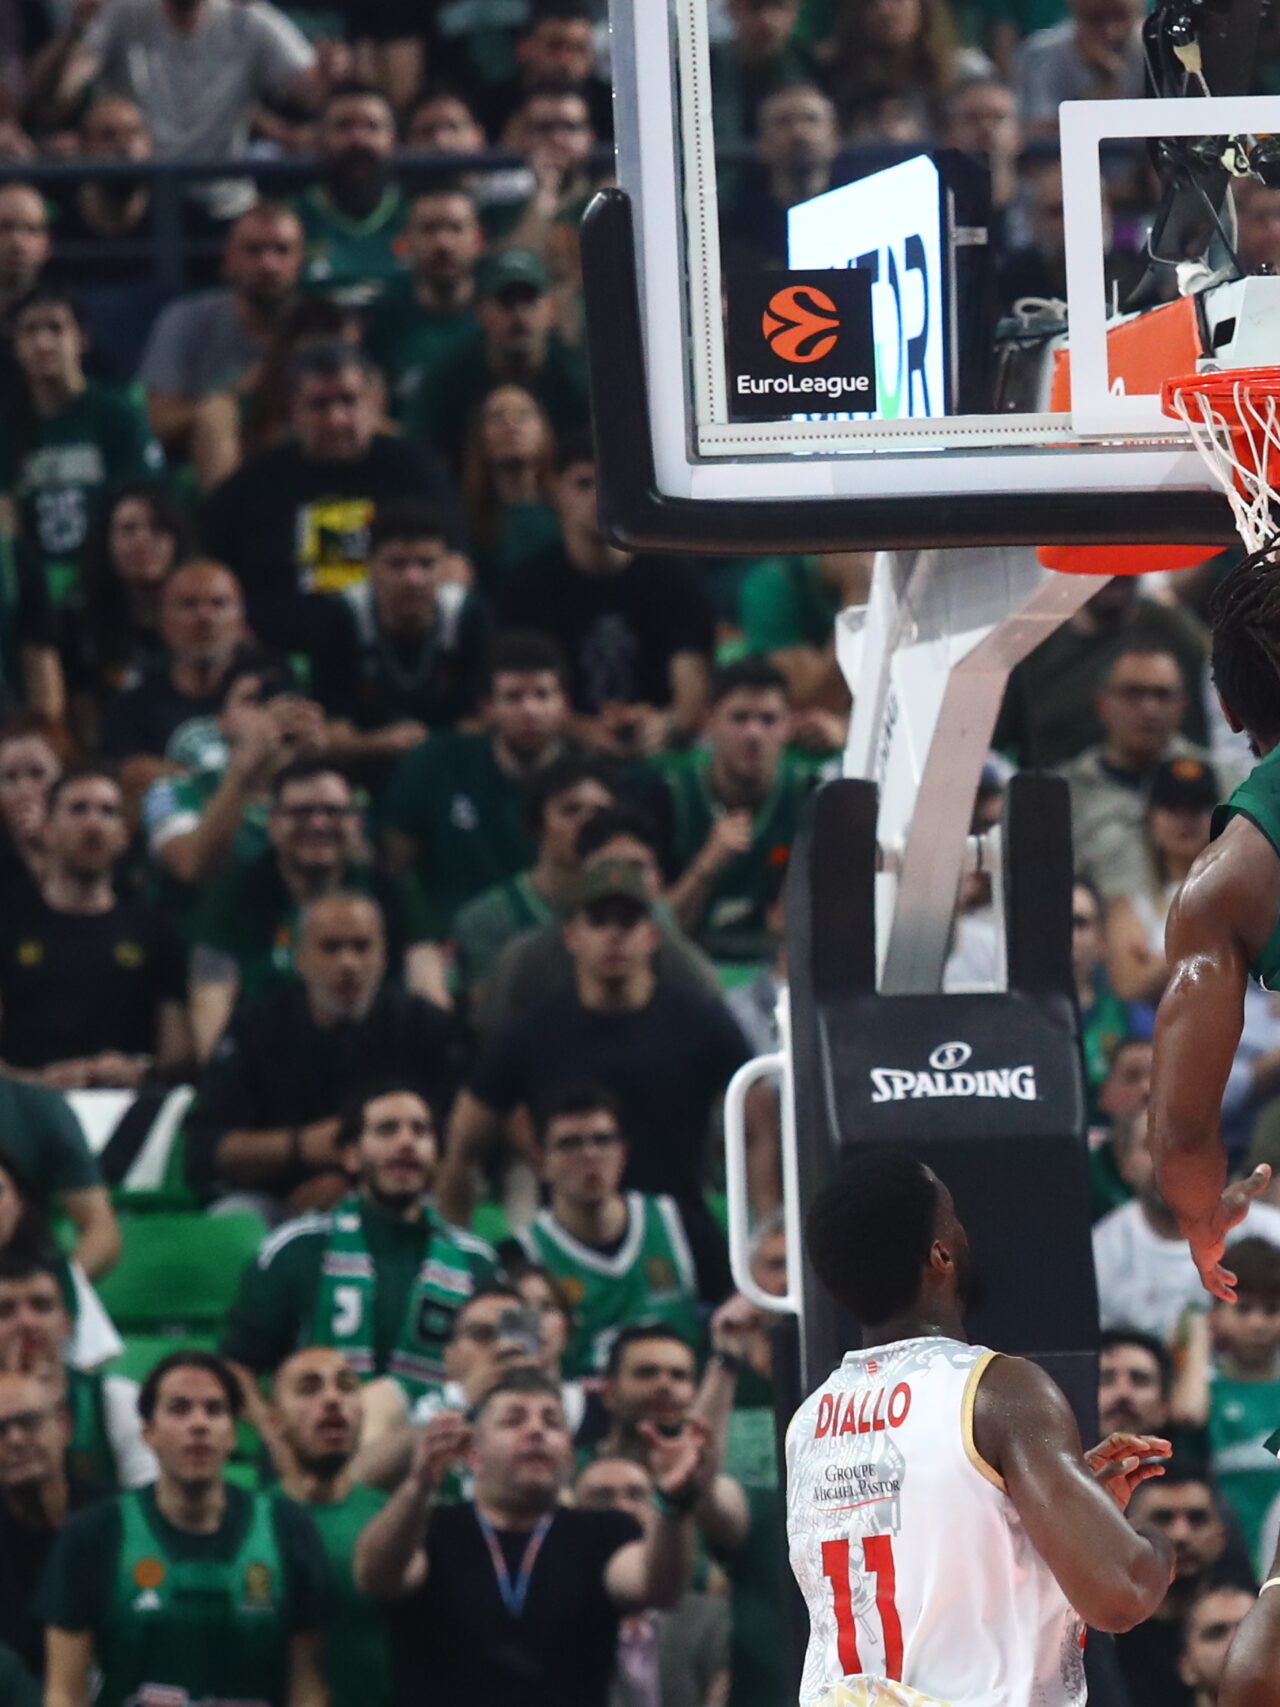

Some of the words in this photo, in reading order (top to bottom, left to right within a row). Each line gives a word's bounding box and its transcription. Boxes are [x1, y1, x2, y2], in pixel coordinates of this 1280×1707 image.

[736, 374, 870, 399] EuroLeague
[870, 1065, 1037, 1104] SPALDING
[814, 1382, 912, 1440] DIALLO
[821, 1534, 904, 1682] 11
